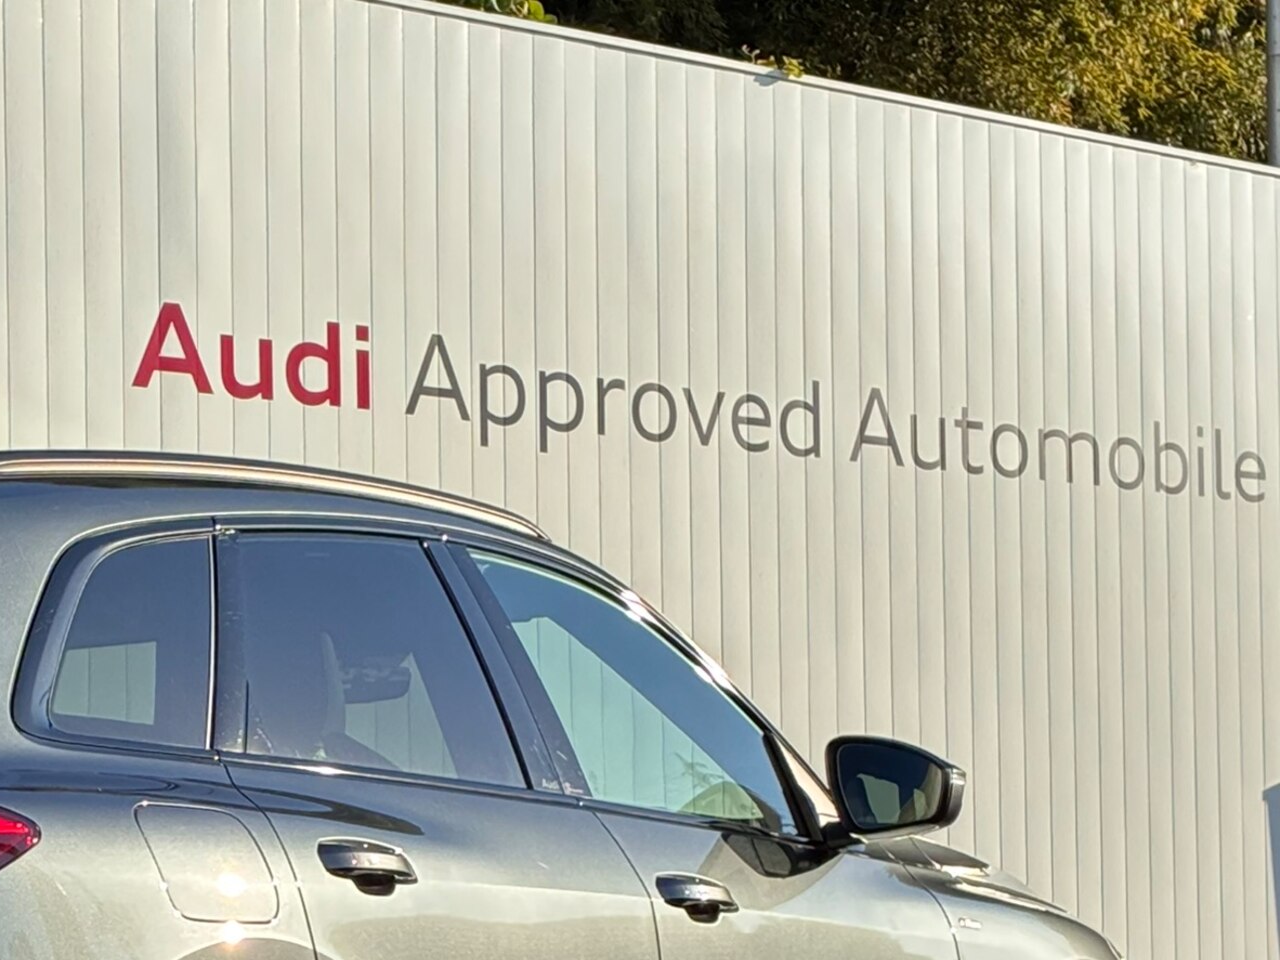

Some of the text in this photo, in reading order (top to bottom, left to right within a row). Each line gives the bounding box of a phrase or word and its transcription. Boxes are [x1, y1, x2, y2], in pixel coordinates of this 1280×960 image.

[131, 301, 1267, 503] Audi Approved Automobile
